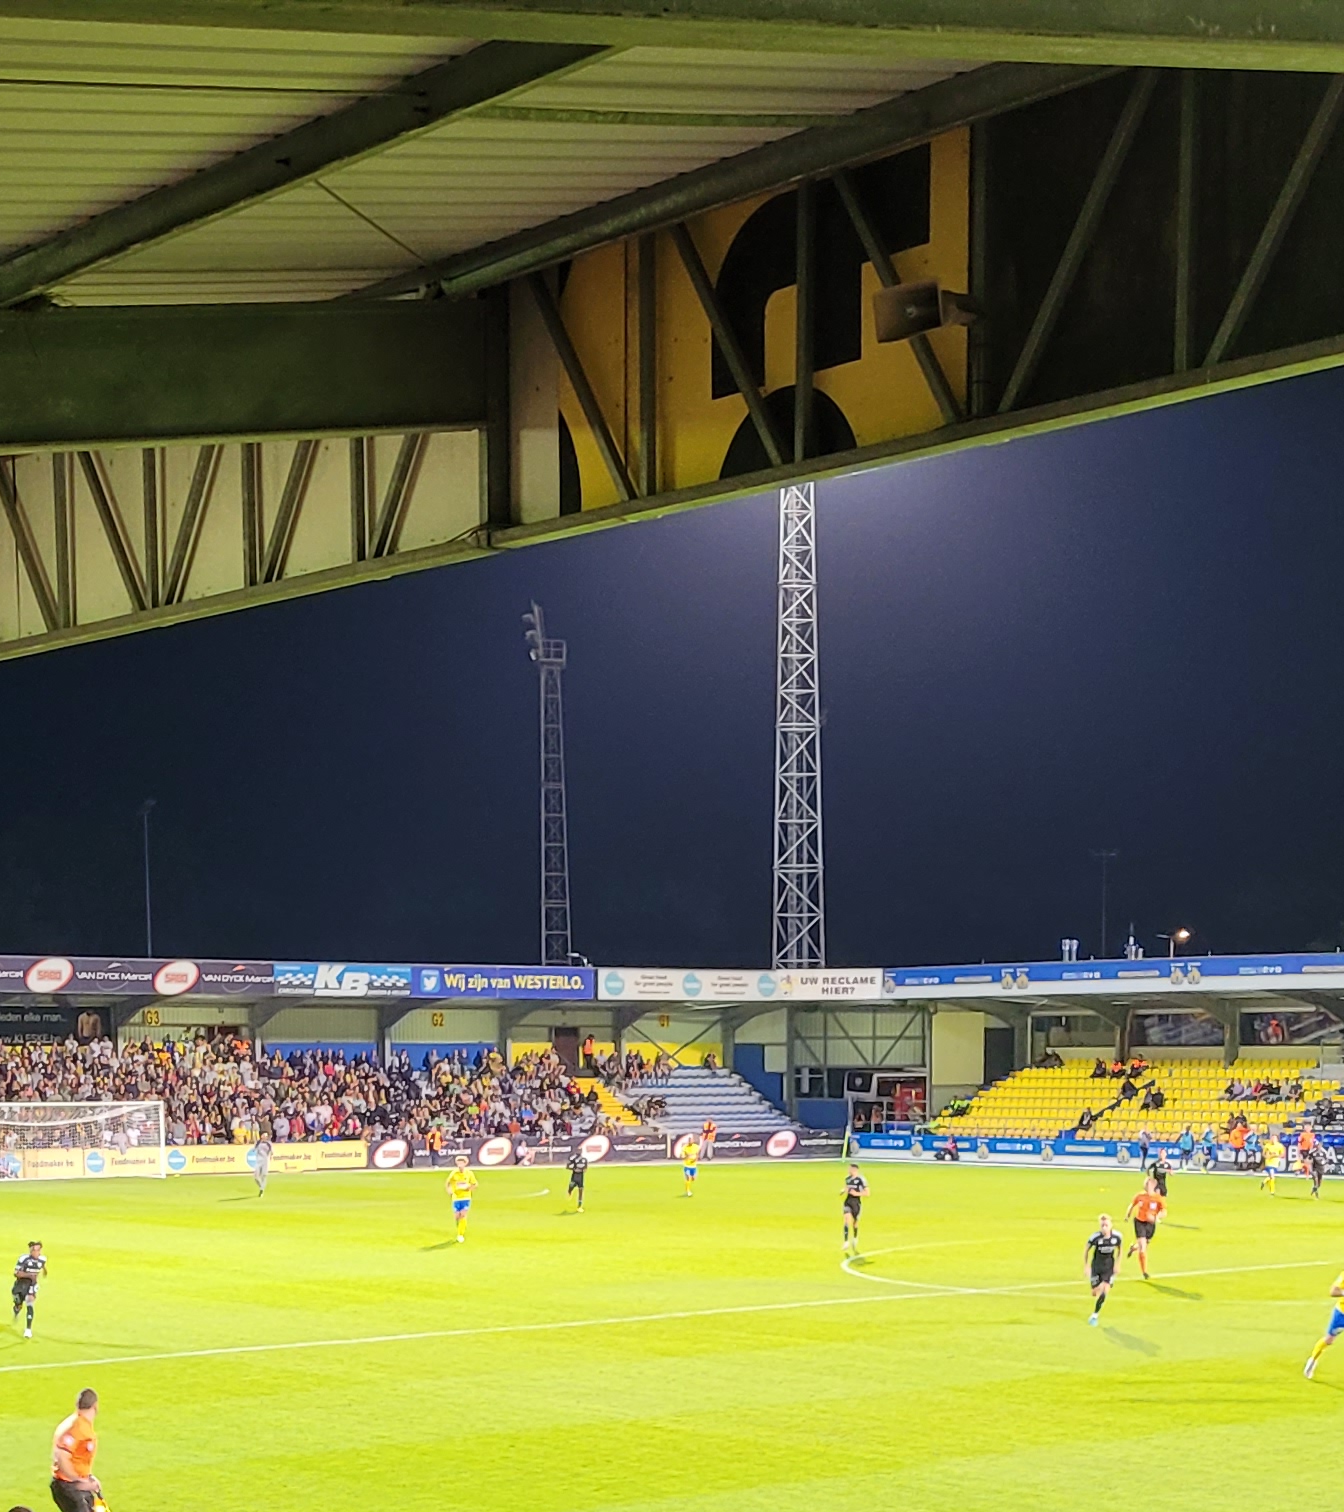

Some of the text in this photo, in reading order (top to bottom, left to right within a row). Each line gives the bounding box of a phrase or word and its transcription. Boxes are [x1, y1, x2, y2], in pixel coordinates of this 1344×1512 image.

[314, 964, 370, 996] KB
[444, 973, 585, 992] Wij zijn van WESTERLO.
[800, 976, 877, 985] UW RECLAME
[821, 987, 856, 995] HIER?
[432, 1012, 445, 1027] G2
